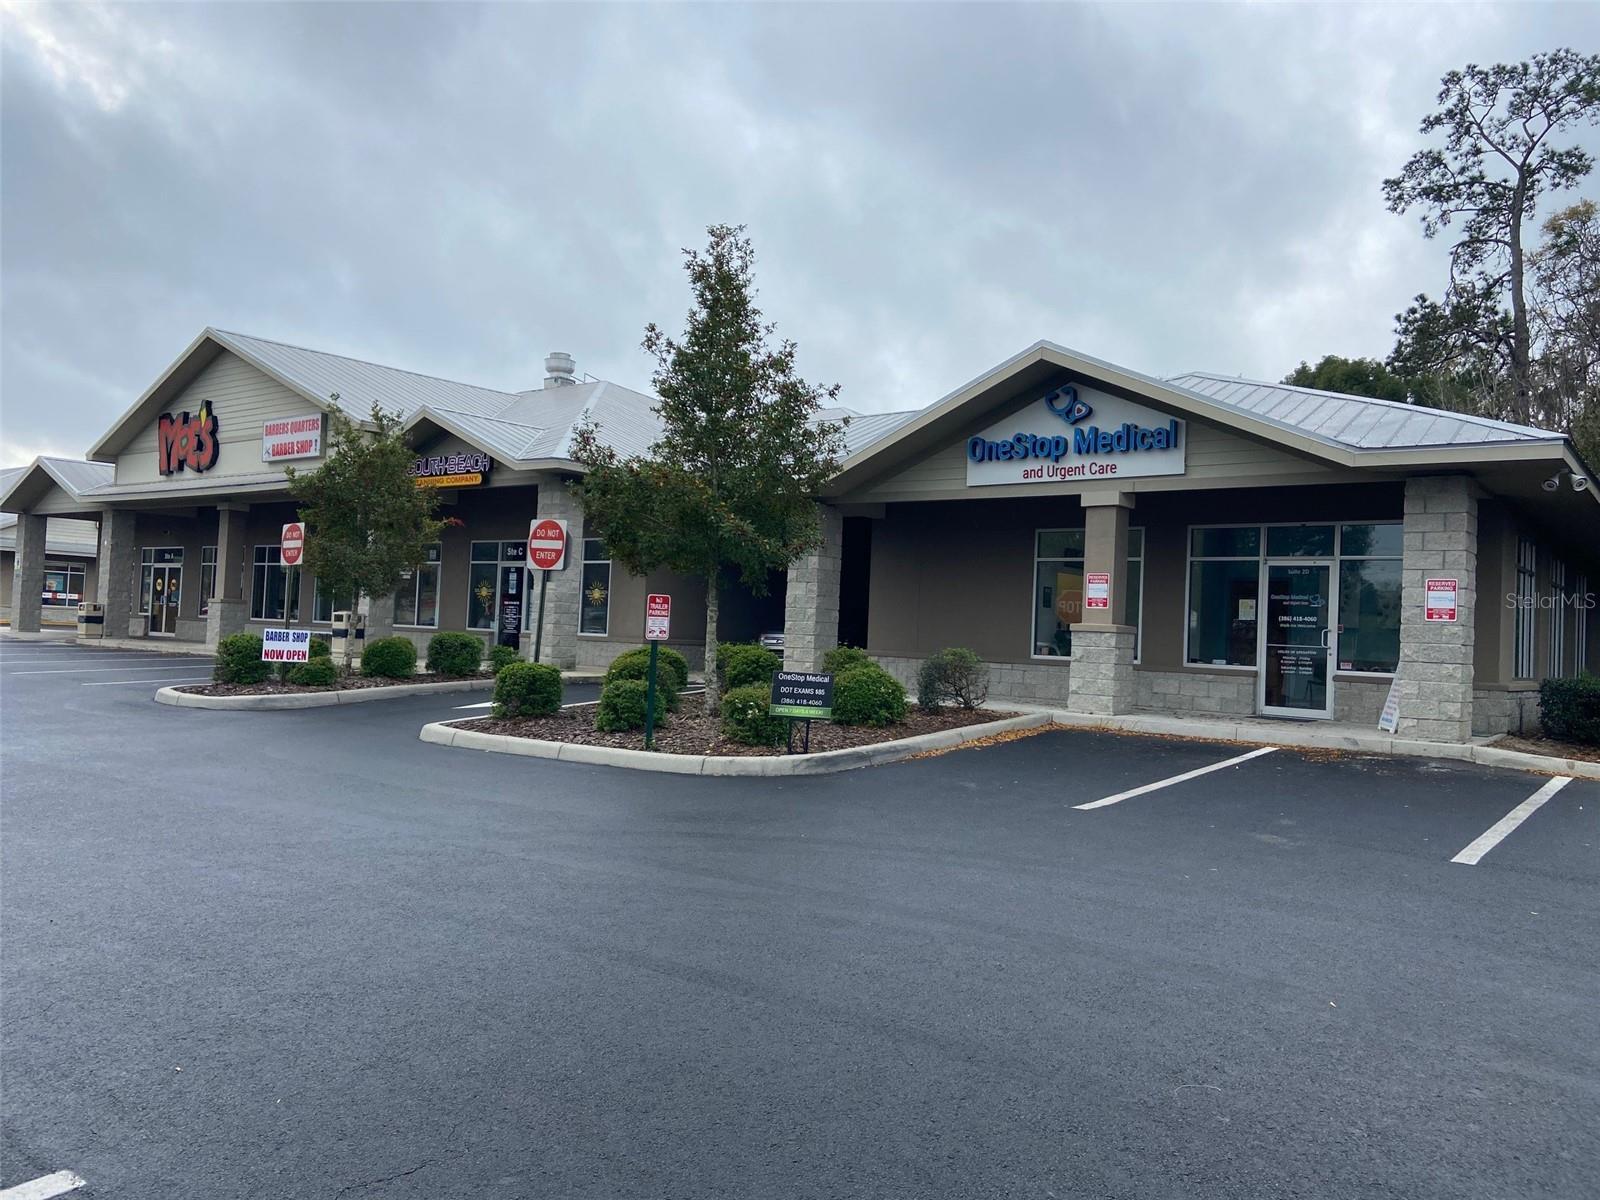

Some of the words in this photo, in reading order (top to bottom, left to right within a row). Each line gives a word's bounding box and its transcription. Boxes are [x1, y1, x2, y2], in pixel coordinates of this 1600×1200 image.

[265, 422, 289, 437] BARBERS
[290, 418, 320, 435] QUARTERS
[968, 432, 1068, 463] OneStop
[1073, 419, 1178, 455] Medical
[271, 441, 295, 457] BARBER
[296, 439, 313, 454] SHOP
[447, 454, 490, 473] BEACH
[1022, 465, 1043, 479] and
[1047, 463, 1086, 480] Urgent
[1089, 462, 1117, 475] Care
[446, 475, 478, 484] COMPANY
[536, 529, 546, 537] DO
[547, 529, 560, 537] NOT
[507, 547, 517, 556] Ste
[518, 547, 523, 556] C
[536, 551, 556, 559] ENTER
[265, 630, 290, 642] BARBER
[292, 631, 308, 643] SHOP
[264, 649, 285, 660] NOW
[286, 649, 307, 660] OPEN
[778, 672, 806, 682] OneStop
[806, 674, 830, 683] Medical
[793, 687, 815, 695] EXAMS
